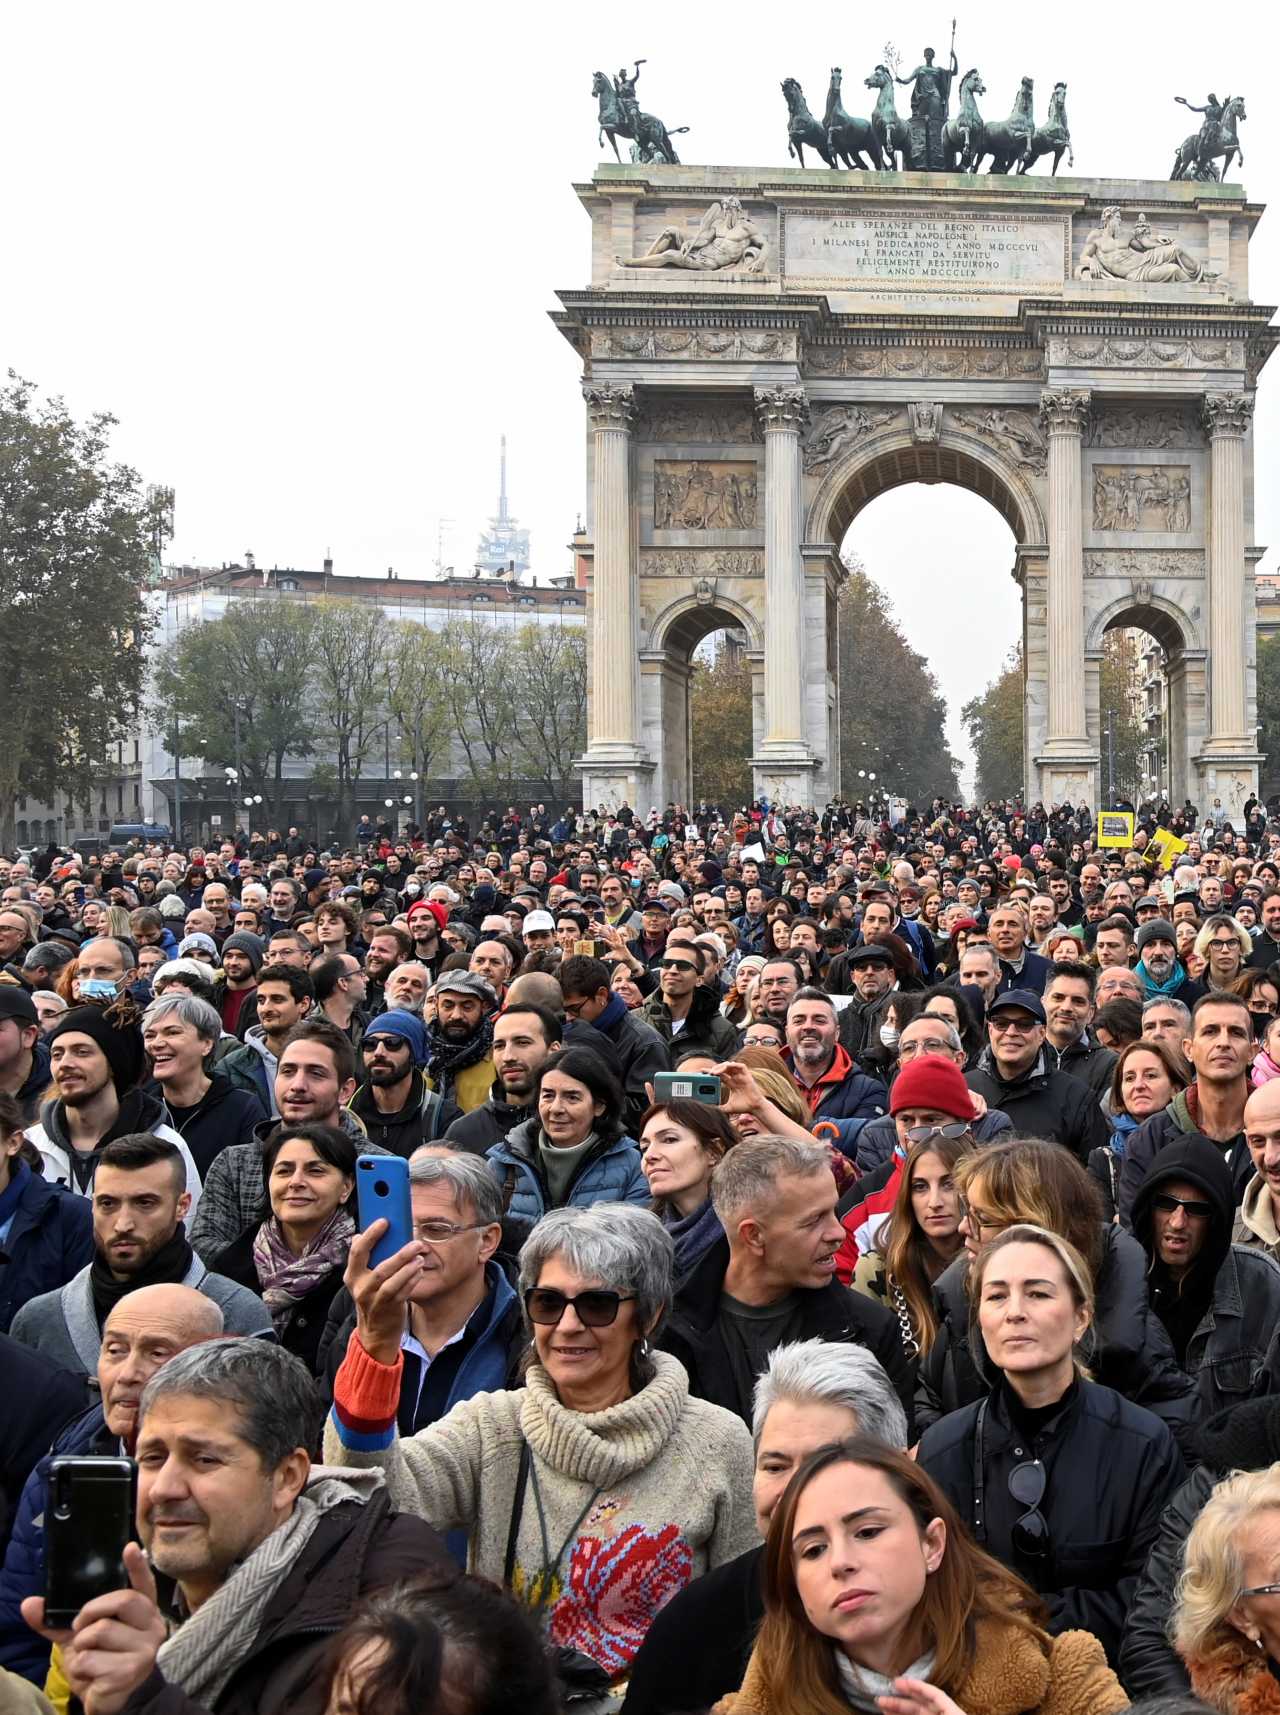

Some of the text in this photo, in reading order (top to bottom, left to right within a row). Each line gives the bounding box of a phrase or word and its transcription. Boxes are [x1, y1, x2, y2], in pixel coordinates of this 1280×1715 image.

[832, 220, 856, 229] ALLE
[863, 221, 913, 230] SPERANZE
[944, 224, 975, 232] REGNO
[982, 225, 1019, 233] ITALICO
[874, 231, 908, 239] AUSPICE
[916, 232, 968, 240] NAPOLEONE
[823, 239, 870, 247] MILANESI
[877, 240, 939, 249] DEDICARONO
[957, 242, 981, 250] ANNO
[876, 249, 924, 257] FRANCATI
[932, 250, 945, 258] DA
[856, 257, 1000, 269] FELICEMENTE RESTITUIRONO
[870, 294, 927, 302] ARCHITETTO
